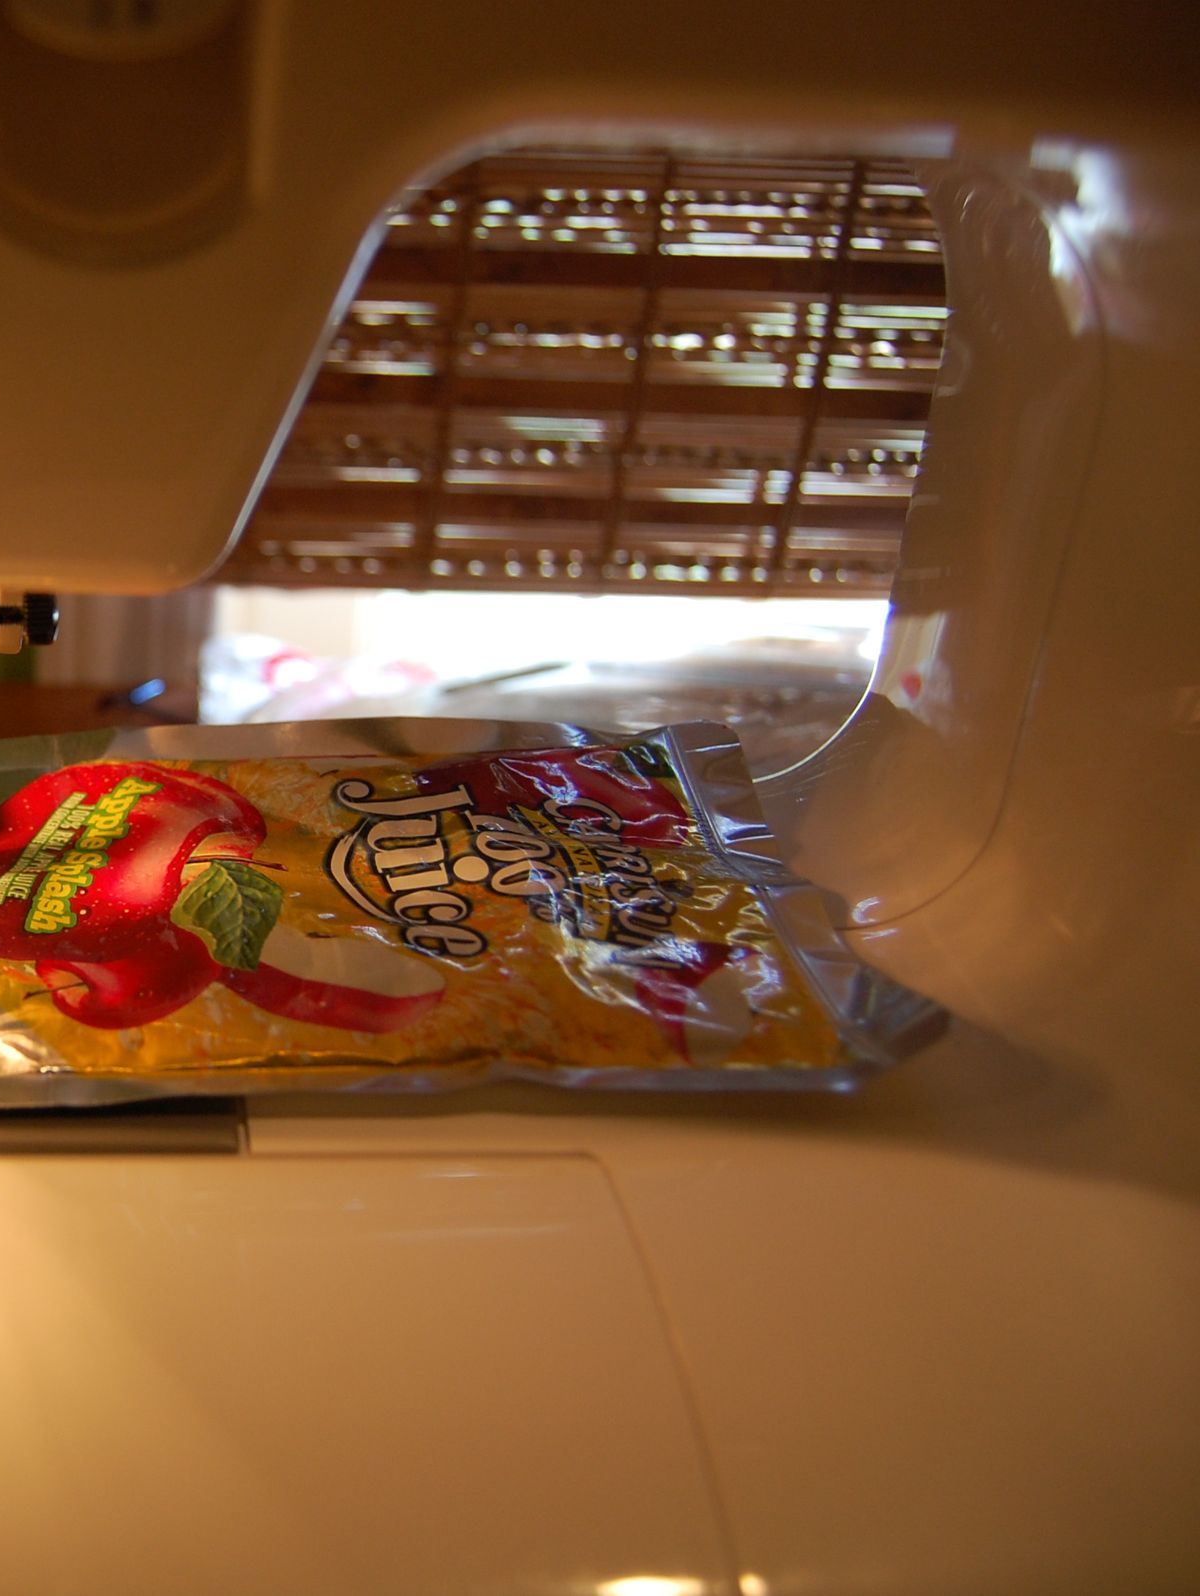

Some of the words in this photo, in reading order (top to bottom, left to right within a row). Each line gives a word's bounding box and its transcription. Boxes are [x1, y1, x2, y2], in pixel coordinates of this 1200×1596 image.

[60, 804, 96, 830] 100%
[79, 778, 158, 849] Apple
[42, 831, 75, 851] REAL
[7, 872, 38, 900] JUICE
[29, 851, 103, 931] Splash
[335, 780, 486, 957] Juice
